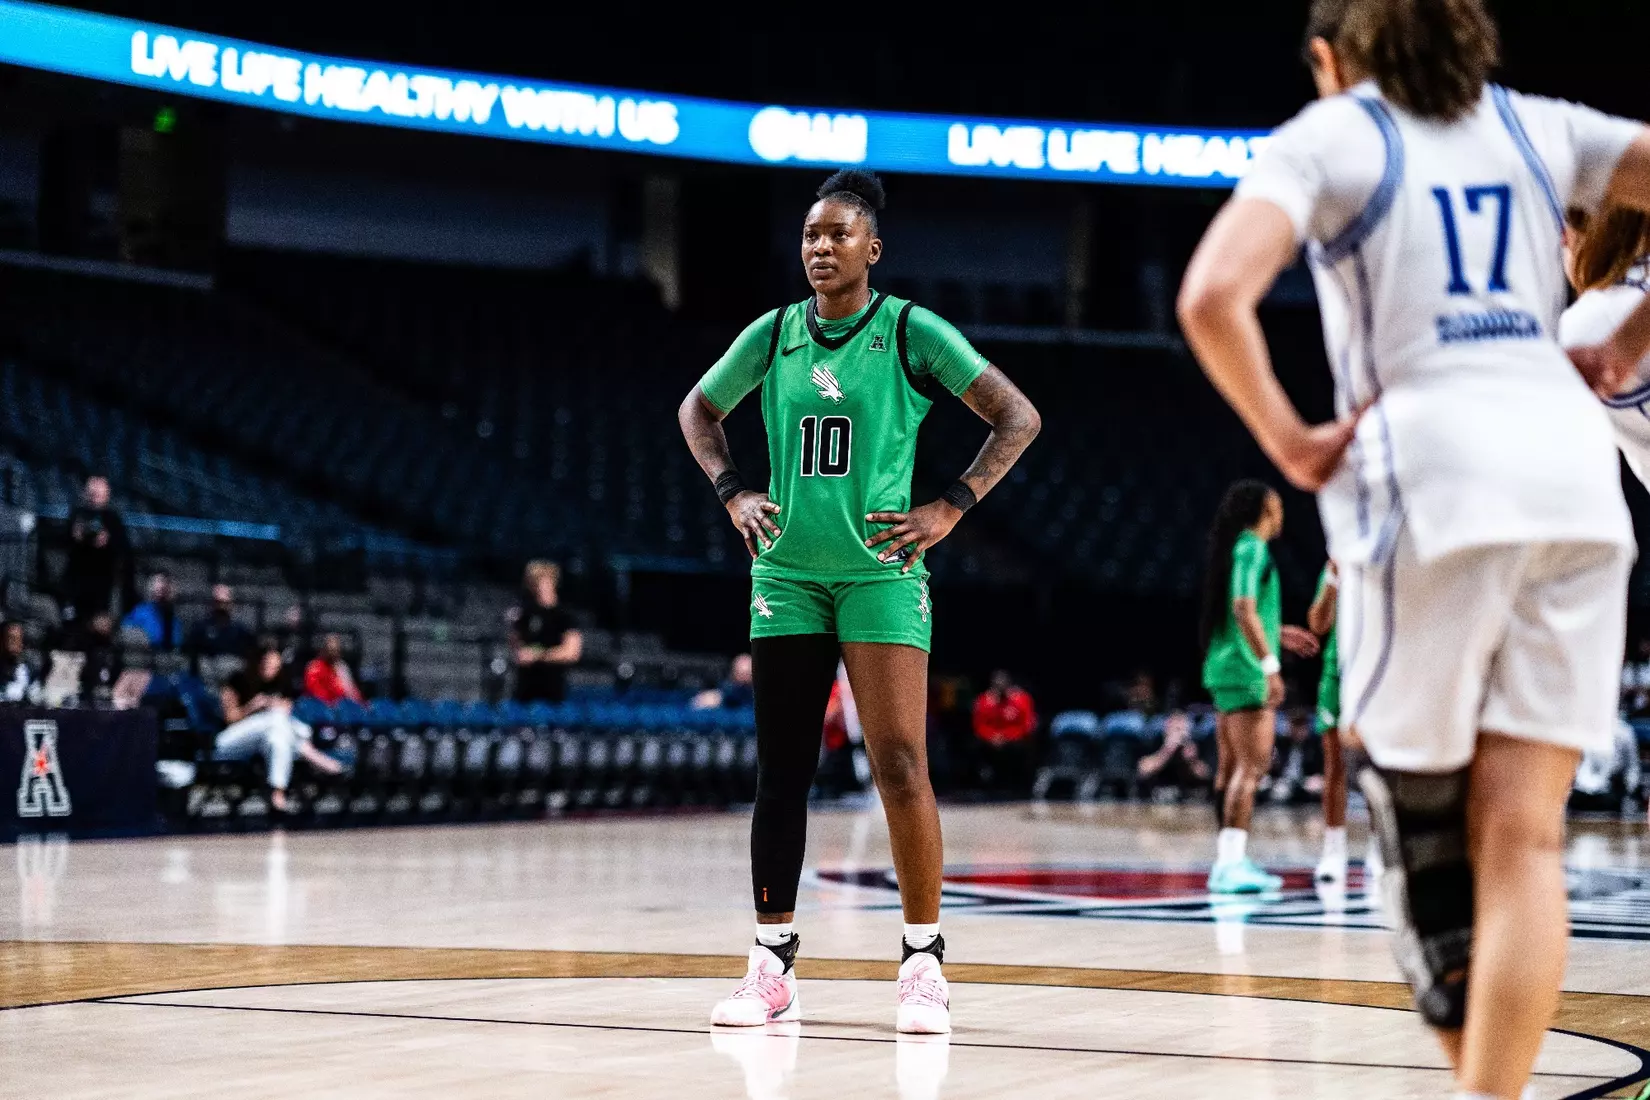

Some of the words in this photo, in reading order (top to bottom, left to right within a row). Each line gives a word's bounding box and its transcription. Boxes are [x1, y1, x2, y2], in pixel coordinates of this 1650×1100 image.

[131, 30, 219, 87] LIVE
[221, 47, 303, 102] LIFE
[304, 63, 500, 125] HEALTHY
[500, 85, 616, 137] WITH
[617, 98, 680, 145] US
[947, 123, 1045, 169] LIVE
[1047, 128, 1140, 174] LIFE
[1431, 184, 1512, 295] 17
[800, 415, 852, 477] 10
